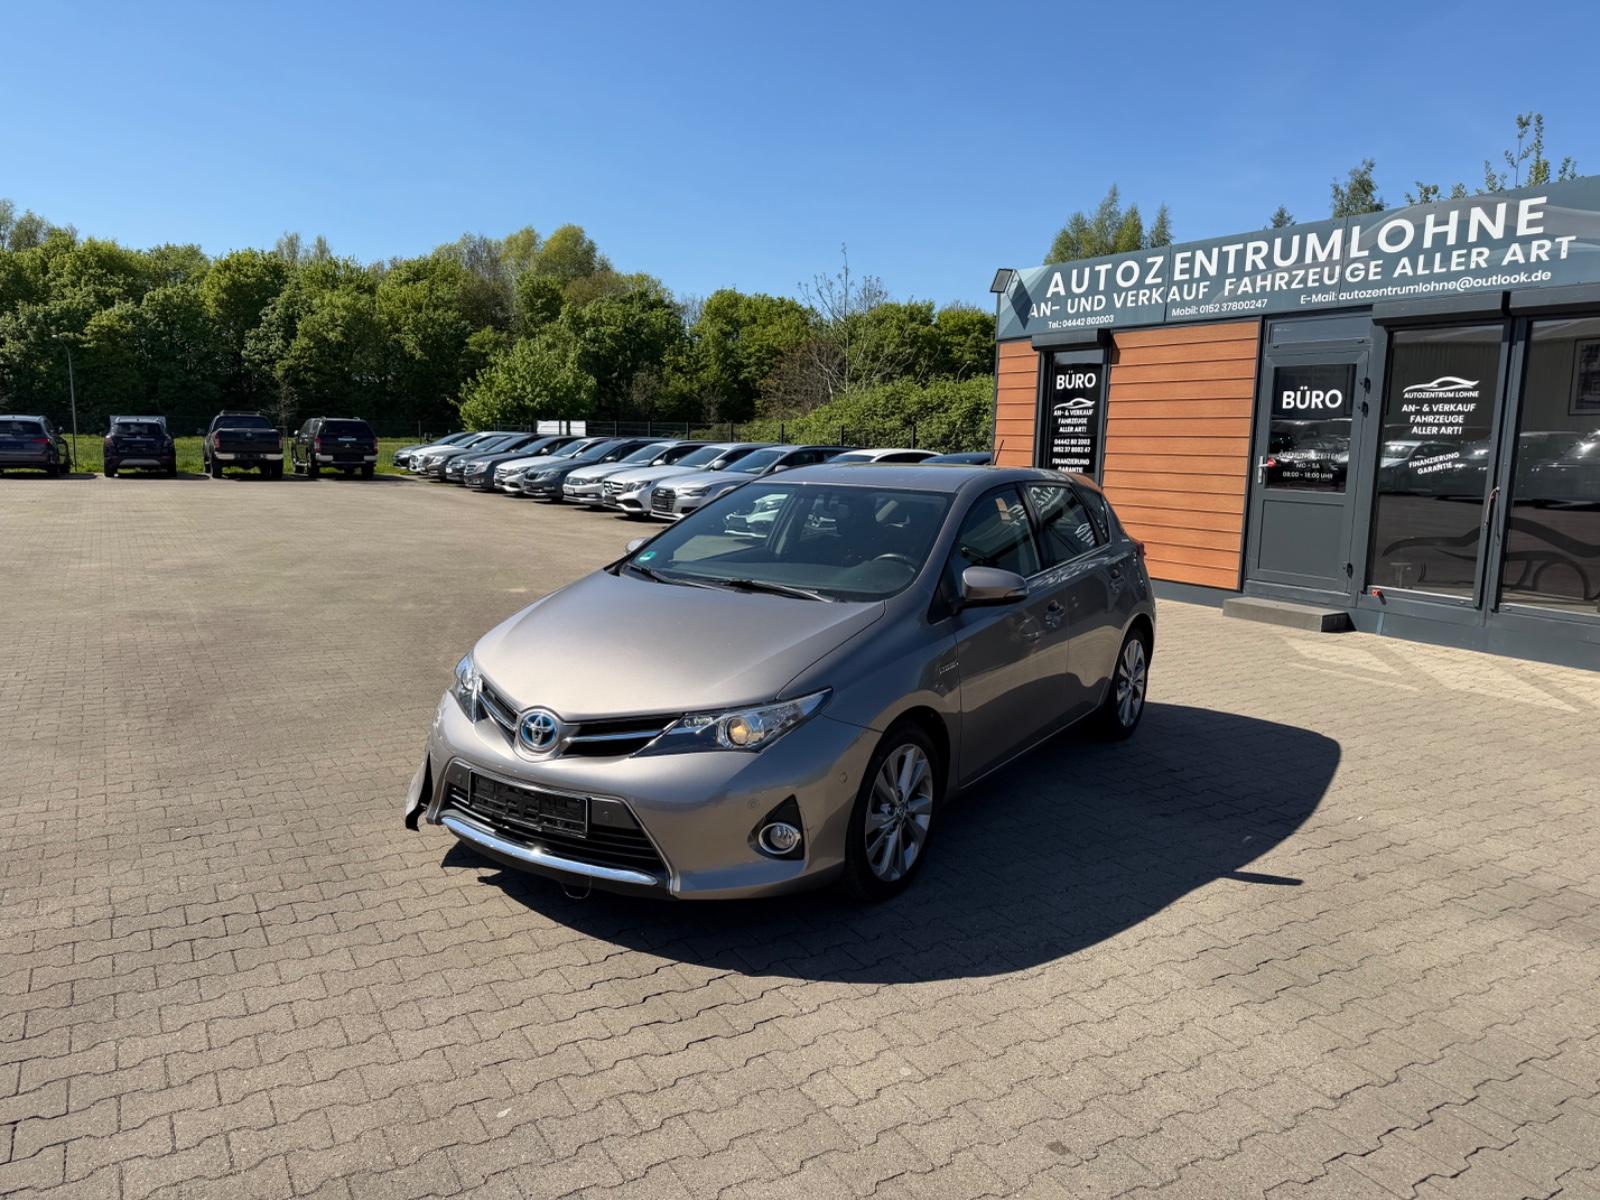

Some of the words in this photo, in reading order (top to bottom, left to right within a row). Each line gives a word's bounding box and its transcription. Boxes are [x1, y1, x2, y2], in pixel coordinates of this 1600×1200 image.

[1027, 301, 1060, 318] AN-
[1067, 294, 1106, 314] UND
[1113, 281, 1210, 309] VERKAUF
[1224, 259, 1384, 297] FAHRZEUGE
[1393, 246, 1490, 278] ALLER
[1501, 235, 1577, 266] ART
[1300, 291, 1337, 304] E-Mail:
[1171, 305, 1198, 317] Mobil:
[1220, 298, 1268, 312] 37800247
[1062, 318, 1085, 328] 04442
[1086, 314, 1115, 325] 802003
[1056, 369, 1096, 390] BÜRO
[1282, 385, 1343, 410] BÜRO
[1403, 391, 1454, 399] AUTOZENTRUM
[1455, 390, 1480, 398] LOHNE
[1070, 408, 1094, 416] VERKAUF
[1401, 403, 1420, 412] AN-
[1422, 403, 1431, 412] &
[1432, 403, 1477, 412] VERKAUF
[1409, 415, 1464, 424] FAHRZEUGE
[1411, 426, 1438, 435] ALLER
[1439, 426, 1462, 435] ART!
[1408, 451, 1460, 469] FINANZIERUNG
[1417, 461, 1453, 475] GARANTIE
